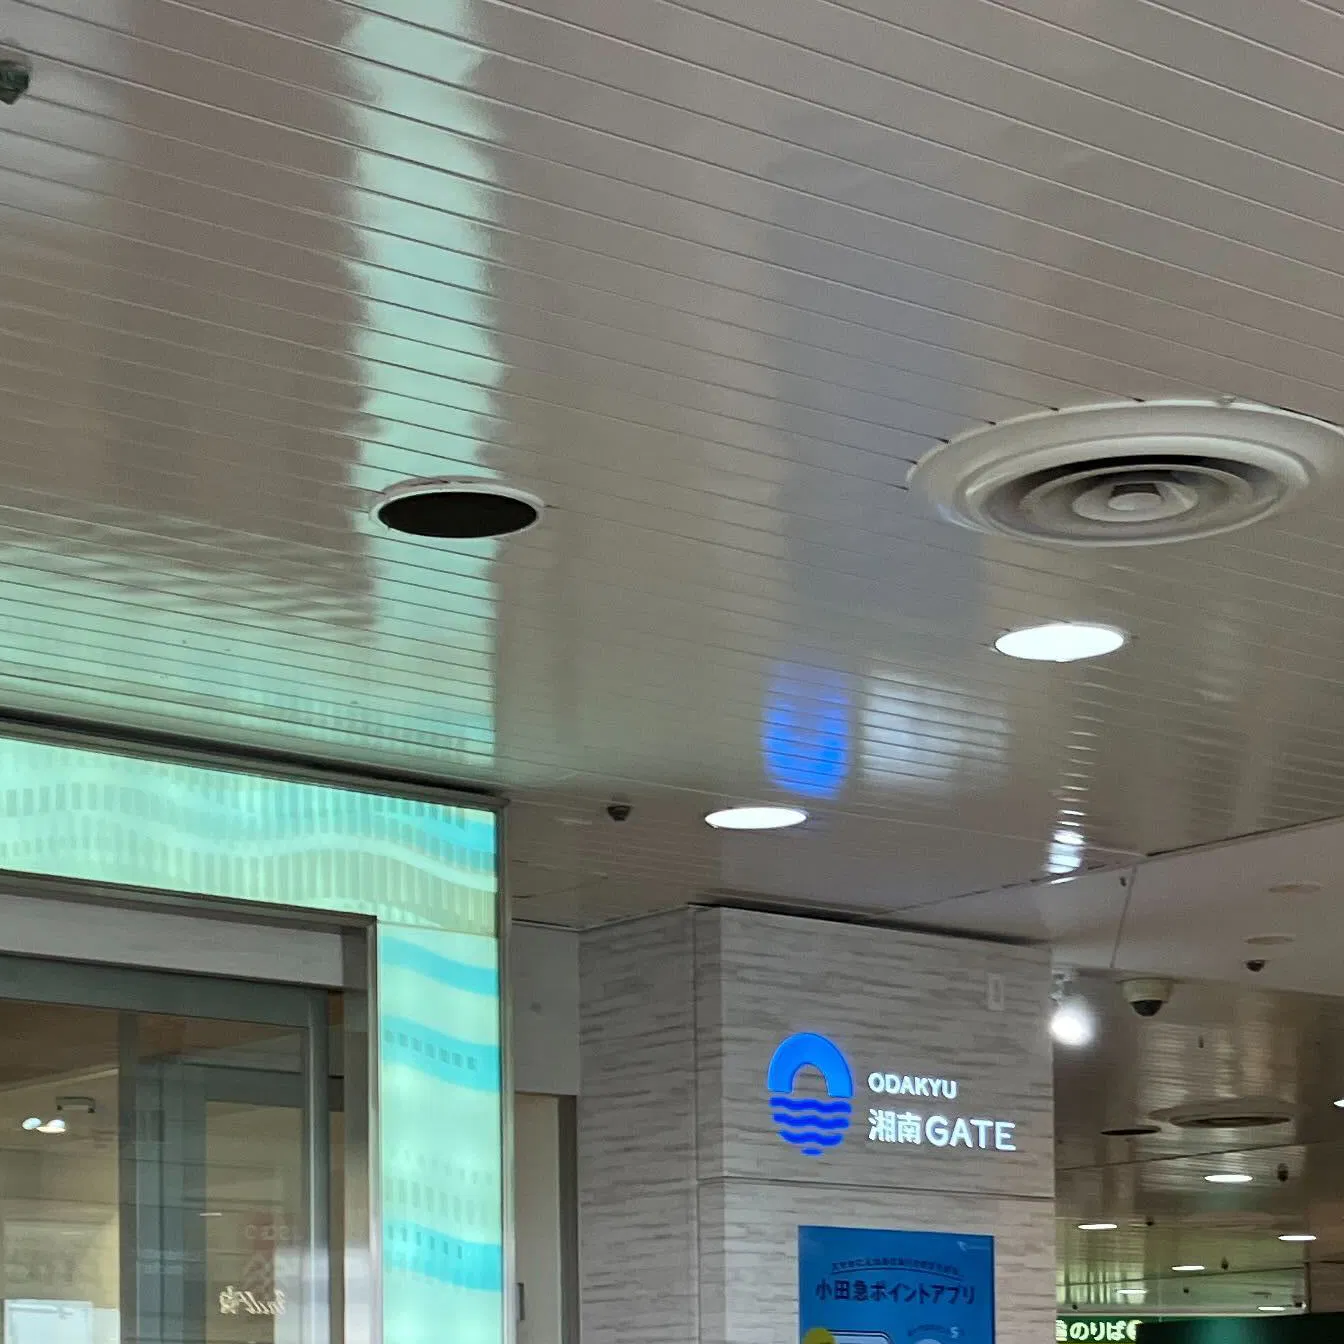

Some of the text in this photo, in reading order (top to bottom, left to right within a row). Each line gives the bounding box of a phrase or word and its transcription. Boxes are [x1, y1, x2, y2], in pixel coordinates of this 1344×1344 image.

[867, 1071, 958, 1100] ODAKYU
[815, 1278, 976, 1305] 小田急ポイントアプリ
